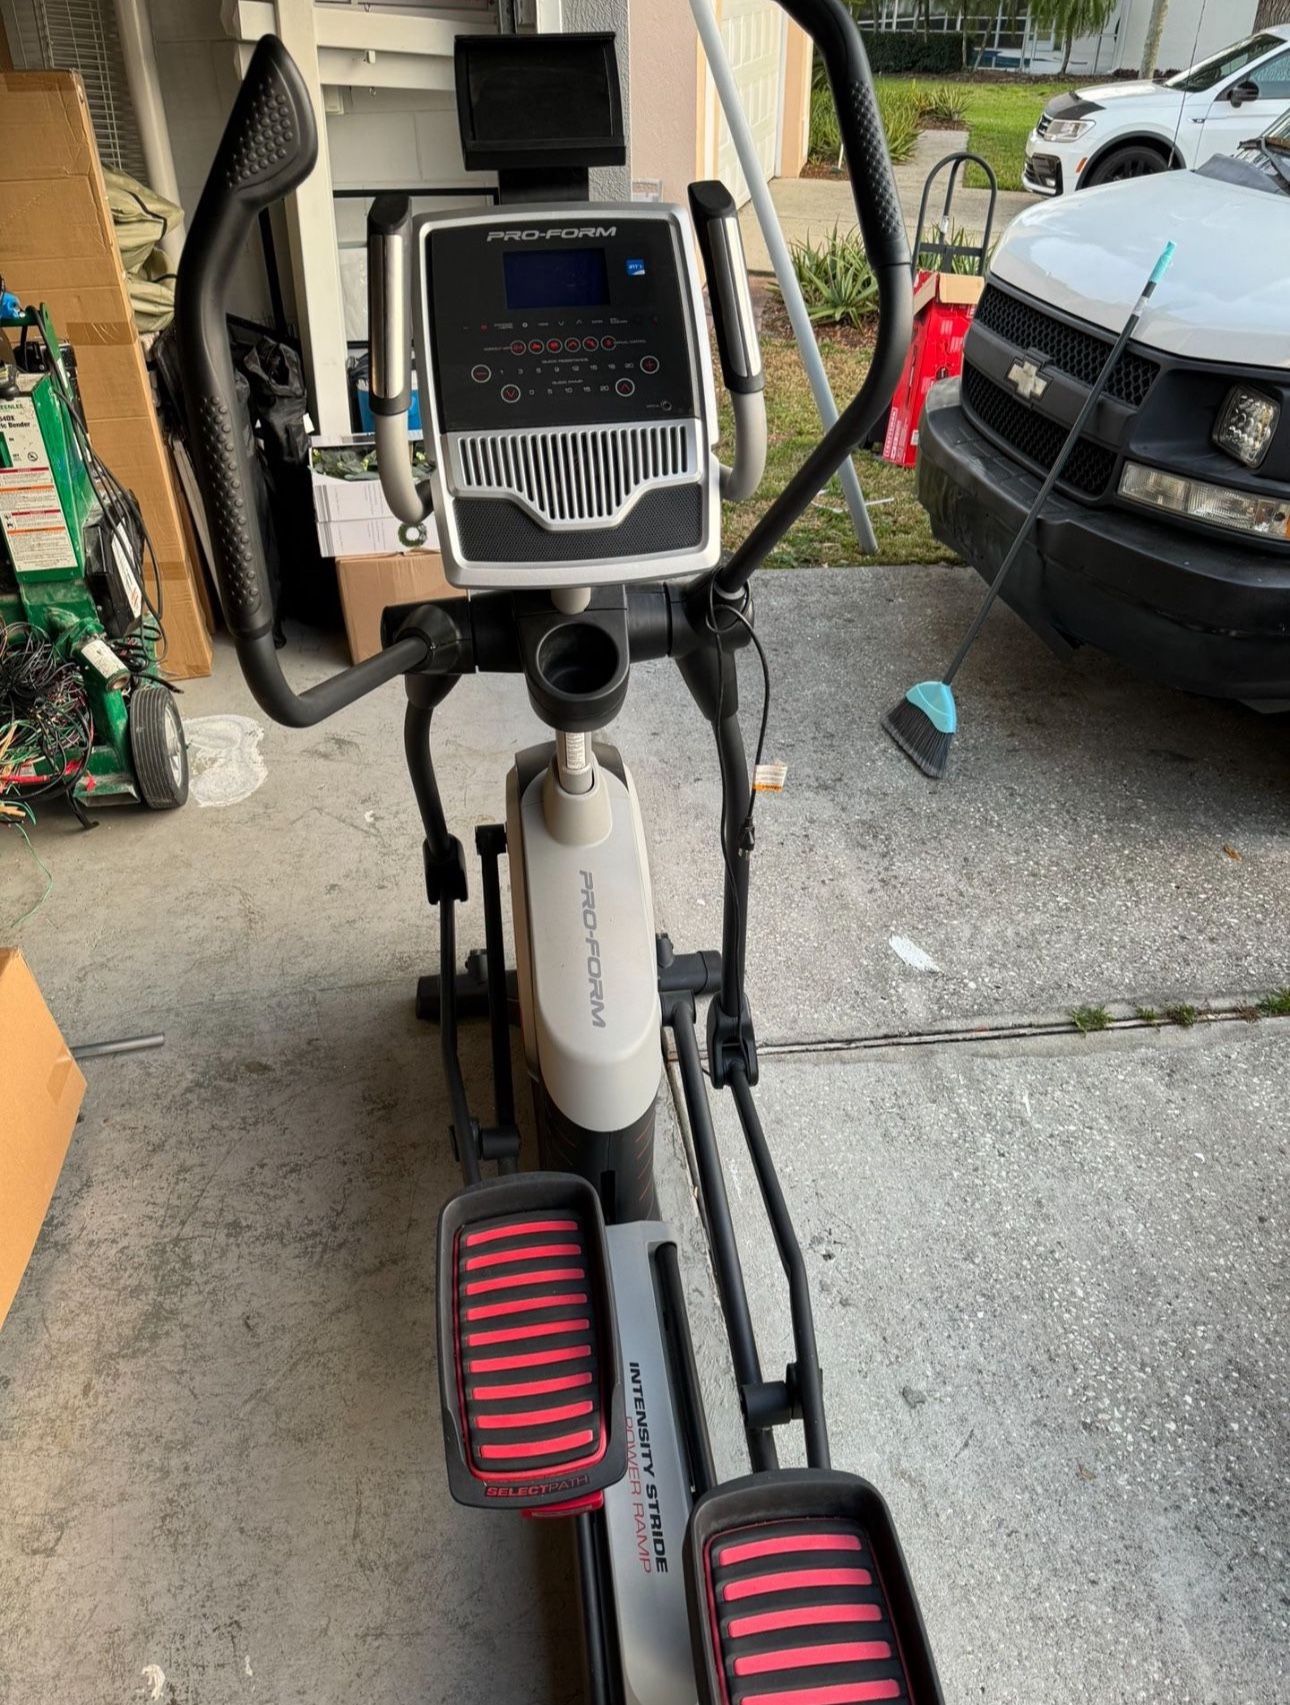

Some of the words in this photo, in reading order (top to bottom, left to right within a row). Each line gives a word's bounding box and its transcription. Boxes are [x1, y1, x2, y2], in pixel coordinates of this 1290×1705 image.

[486, 226, 617, 242] PRO-FORM
[579, 869, 606, 1029] PRO-FORM
[486, 1474, 591, 1498] SELECTPATH
[629, 1362, 655, 1478] INTENSITY
[646, 1485, 668, 1574] STRIDE
[633, 1502, 652, 1574] RAMP
